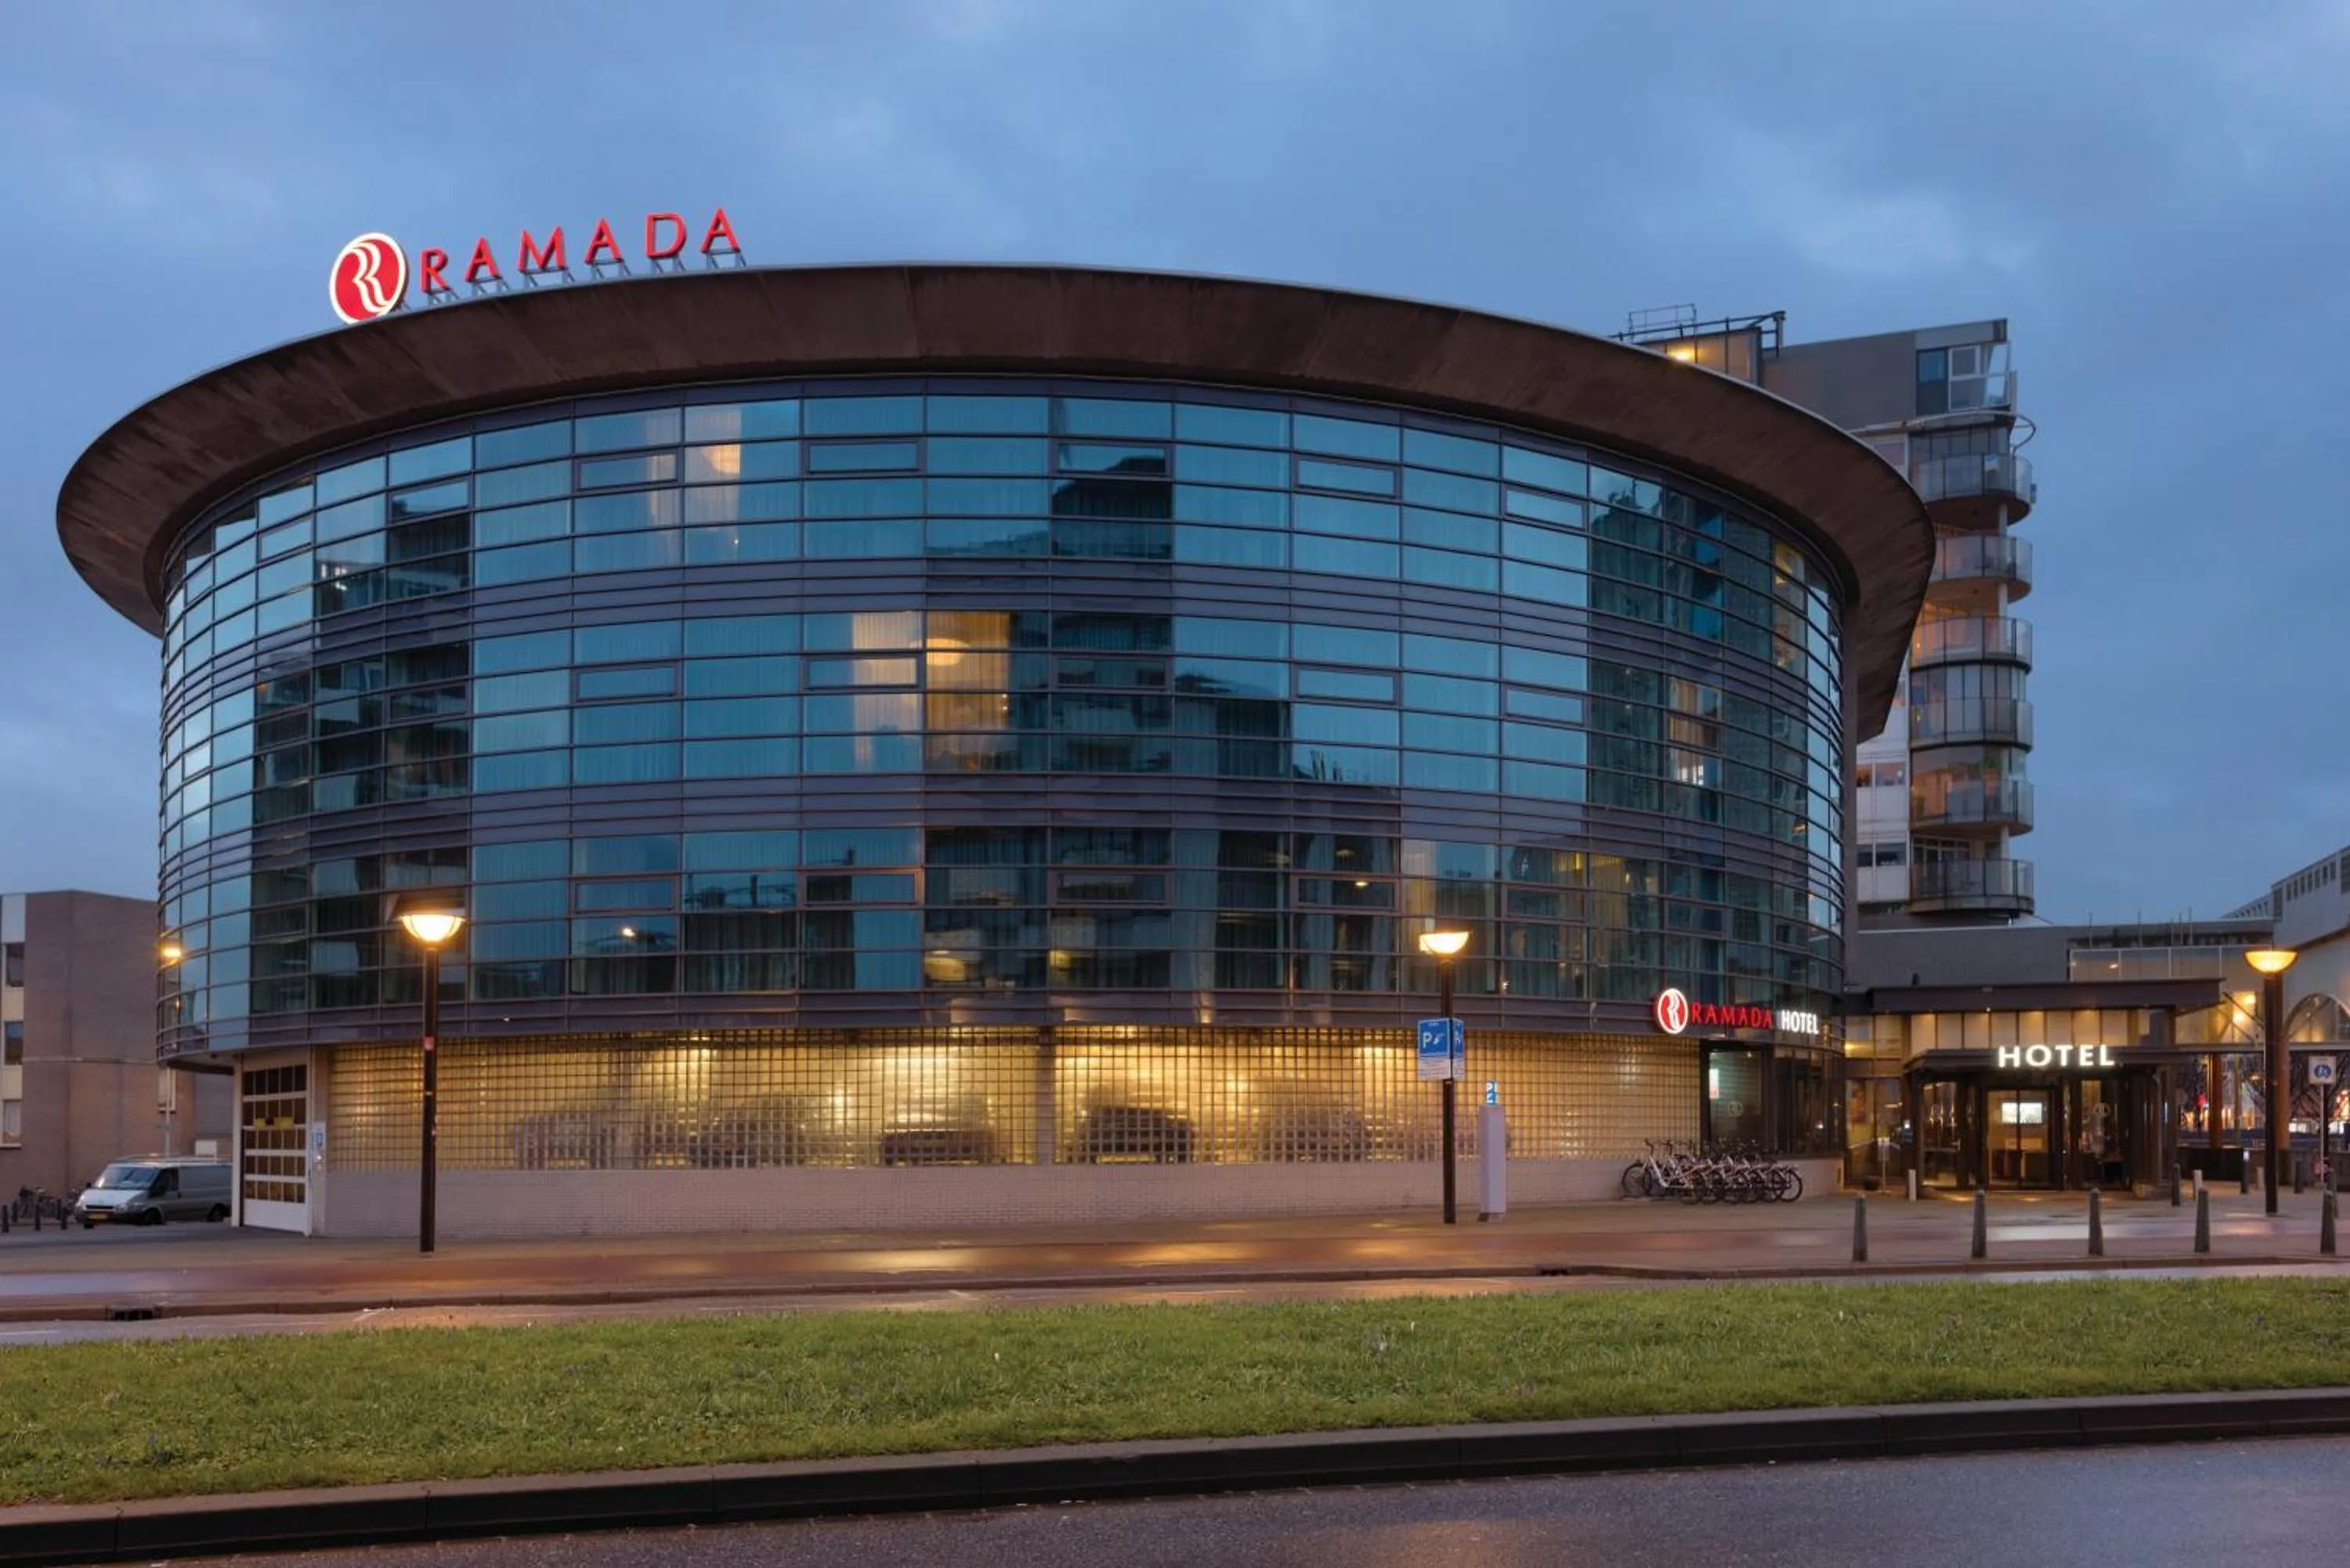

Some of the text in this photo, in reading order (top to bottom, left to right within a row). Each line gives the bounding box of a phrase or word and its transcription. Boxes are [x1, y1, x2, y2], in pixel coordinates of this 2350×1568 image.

[420, 207, 741, 294] RAMADA
[1690, 1002, 1820, 1034] RAMADA HOTEL
[1422, 1031, 1433, 1050] P
[1998, 1043, 2116, 1068] HOTEL
